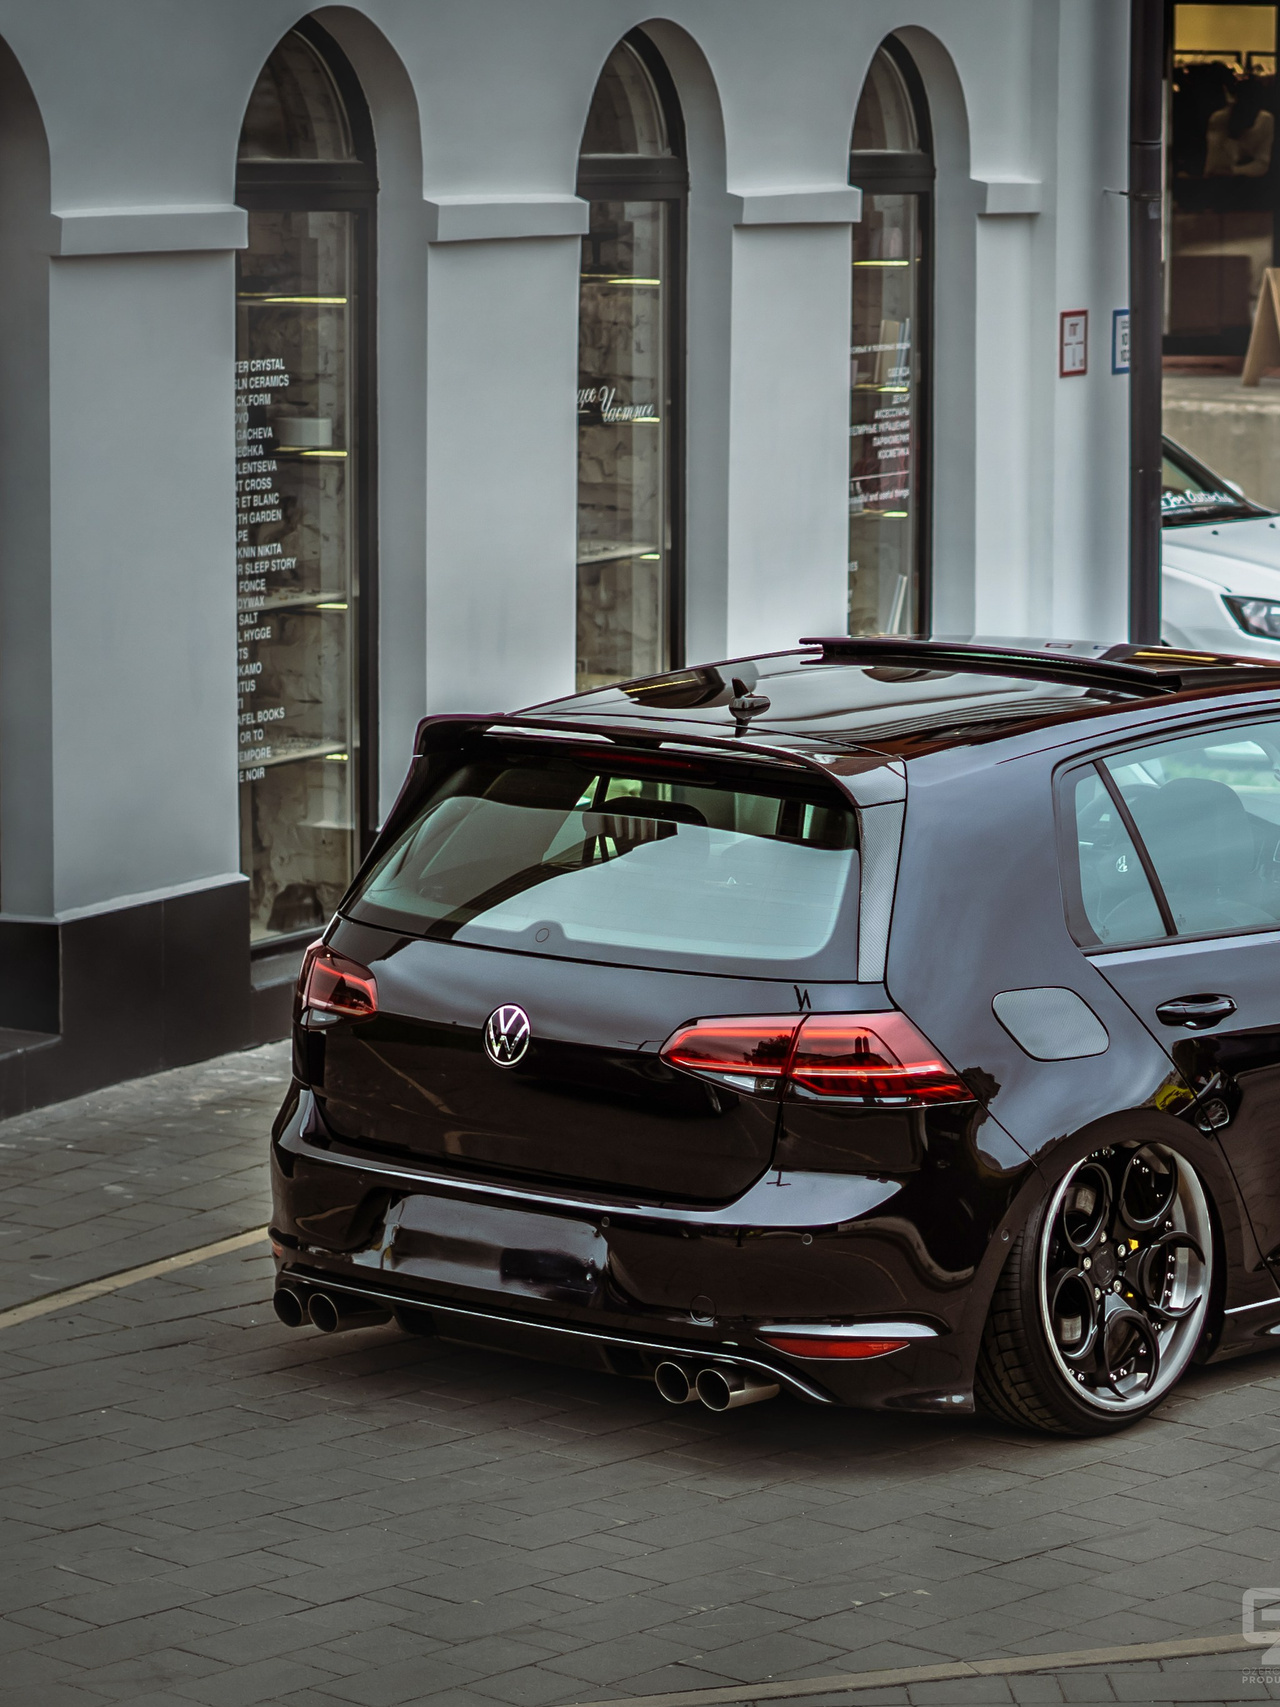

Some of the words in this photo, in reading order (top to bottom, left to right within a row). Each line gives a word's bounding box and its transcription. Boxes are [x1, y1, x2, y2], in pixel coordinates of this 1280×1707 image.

[250, 358, 285, 372] CRYSTAL
[249, 374, 289, 389] CERAMICS
[244, 477, 272, 491] CROSS
[241, 496, 252, 508] ET
[253, 492, 280, 507] BLANC
[249, 509, 282, 524] GARDEN
[257, 543, 282, 557] NIKITA
[245, 560, 270, 575] SLEEP
[271, 557, 297, 572] STORY
[239, 578, 266, 593] FONCE
[239, 612, 259, 626] SALT
[244, 626, 272, 642] HYGGE
[257, 706, 285, 723] BOOKS
[240, 731, 252, 744] OR
[253, 728, 264, 741] TO
[245, 766, 265, 781] NOIR
